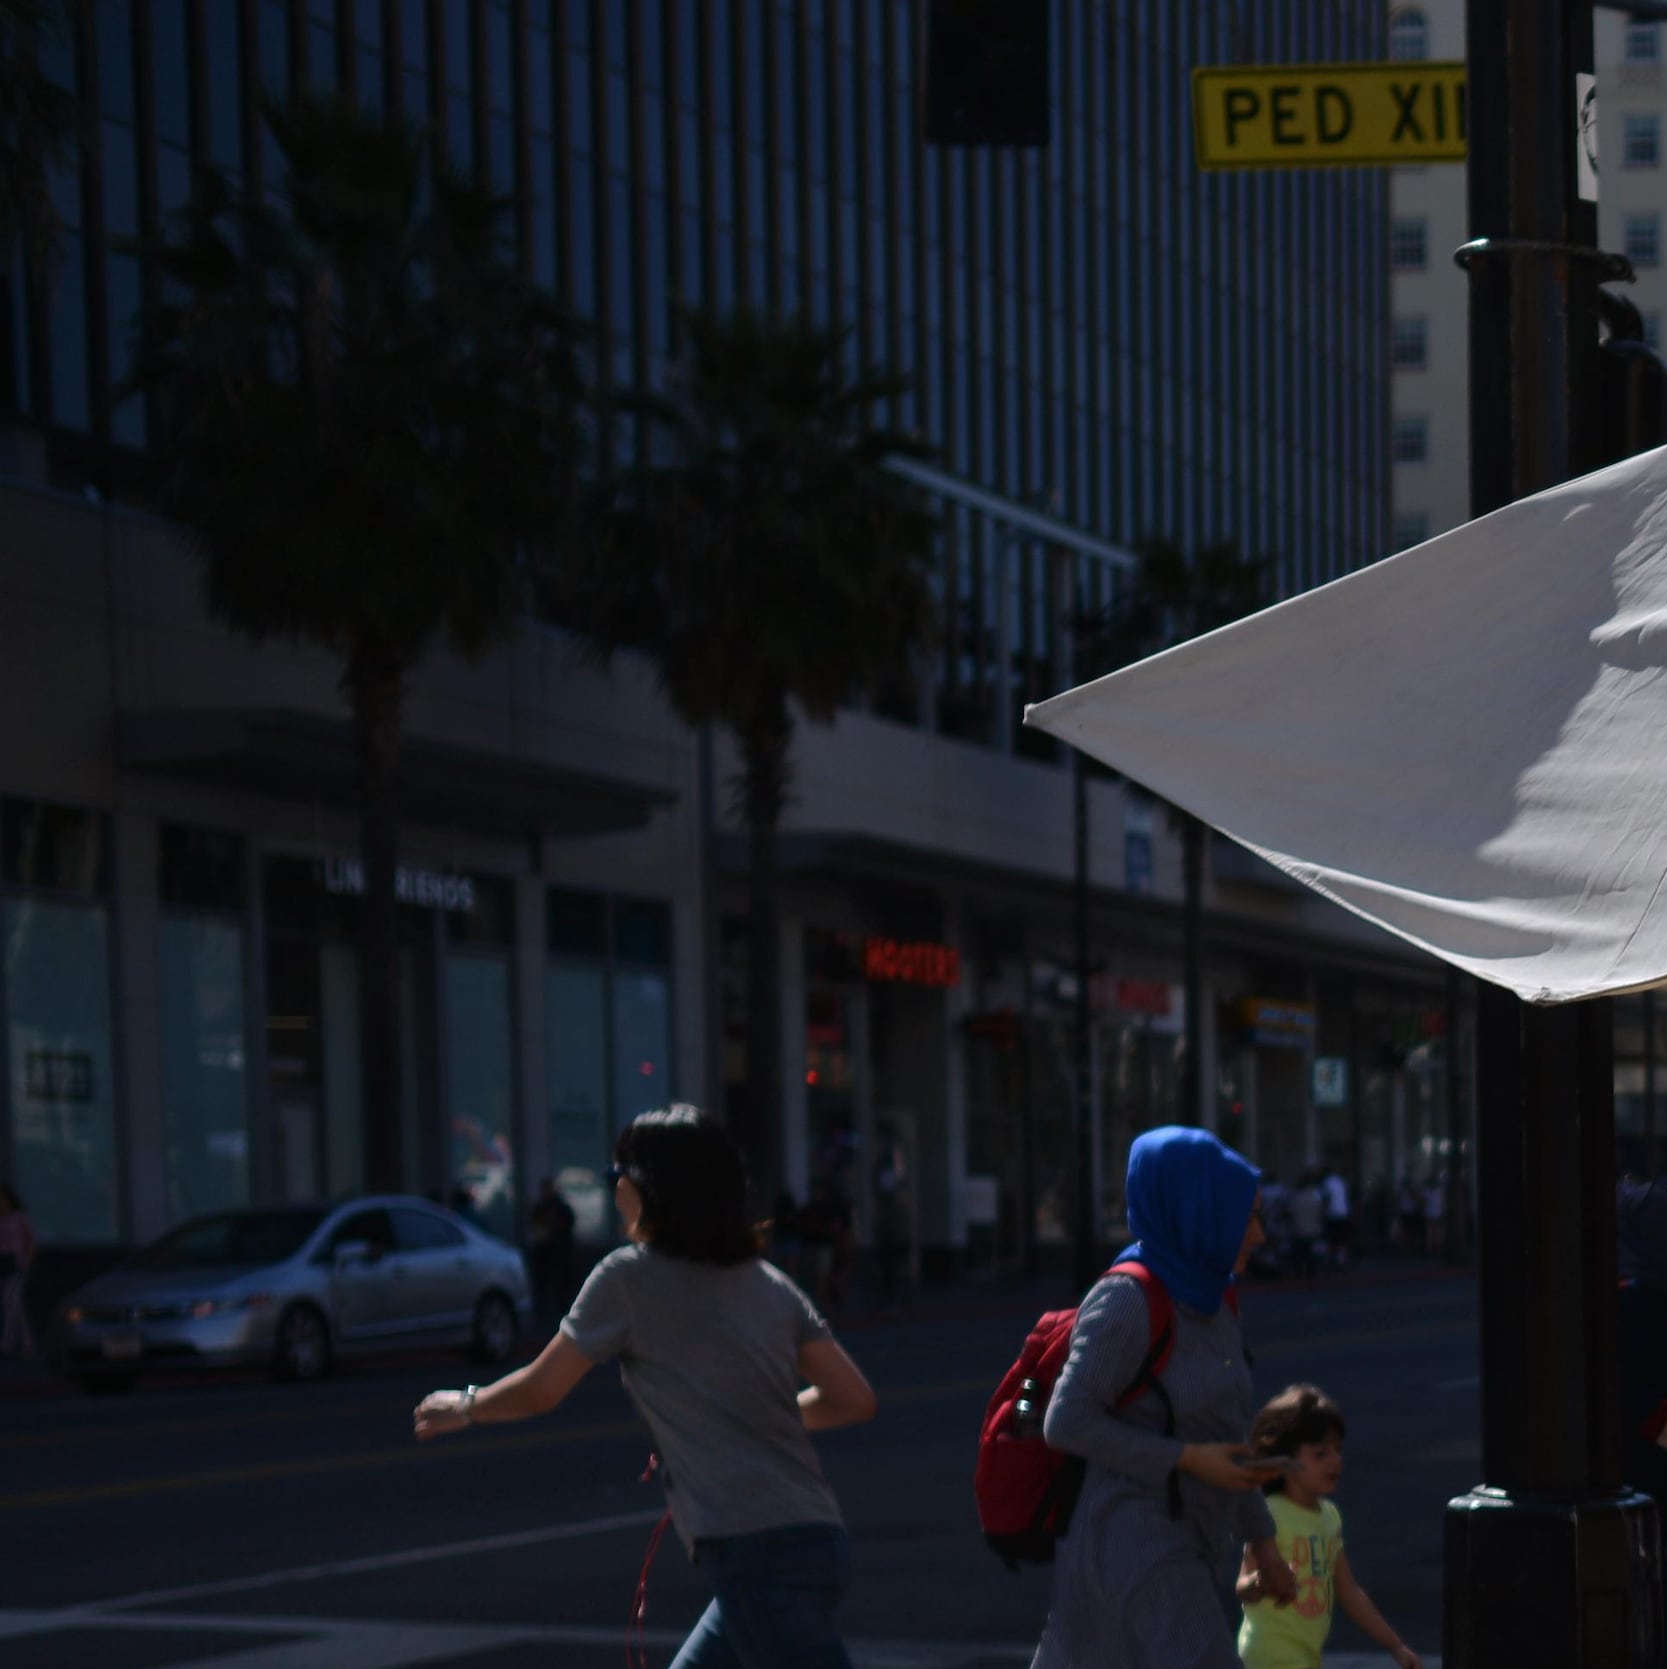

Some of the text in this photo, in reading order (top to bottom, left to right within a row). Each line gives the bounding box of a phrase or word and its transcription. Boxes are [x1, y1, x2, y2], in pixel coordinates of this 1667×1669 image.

[1224, 86, 1353, 145] PED
[323, 855, 476, 913] LIN RIENDS
[864, 935, 960, 988] HOOTERS
